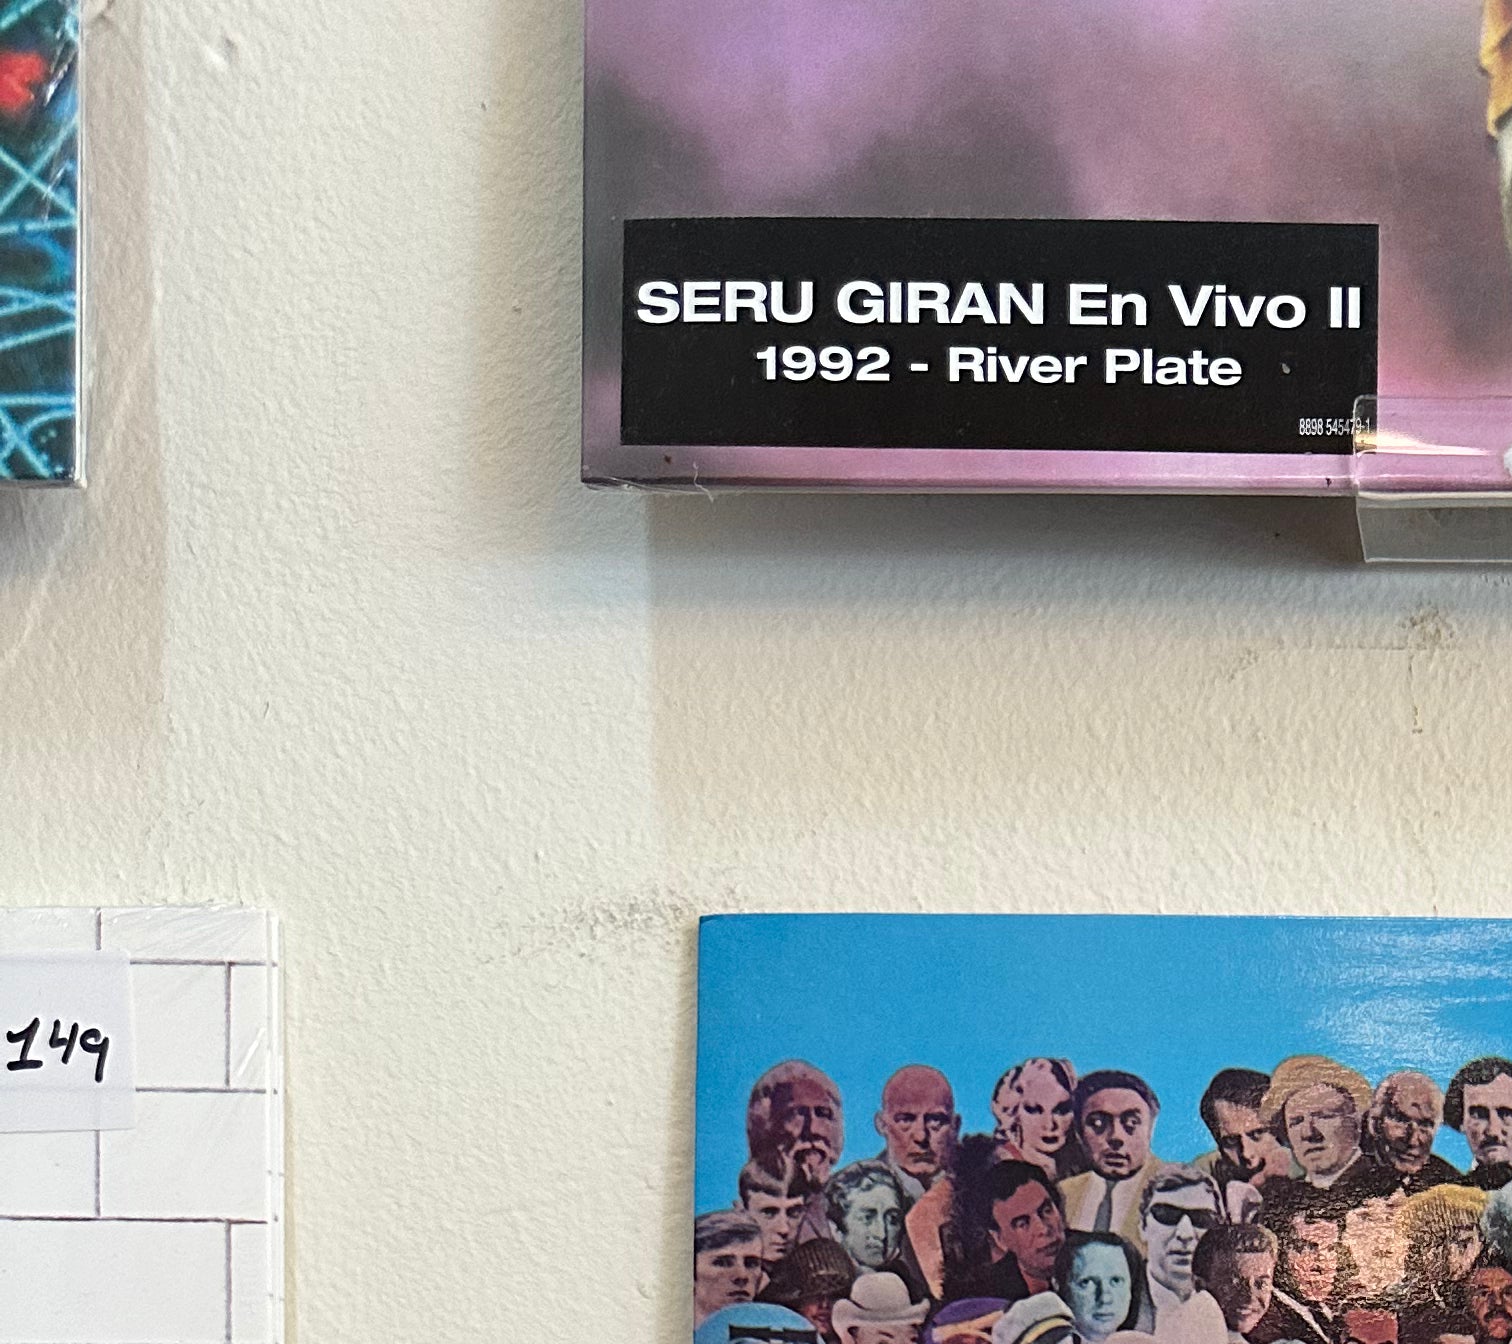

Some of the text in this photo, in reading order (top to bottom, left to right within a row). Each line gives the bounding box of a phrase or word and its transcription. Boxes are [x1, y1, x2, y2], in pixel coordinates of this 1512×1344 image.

[636, 280, 1362, 330] SERU GIRAN En Vivo II
[756, 346, 891, 382] 1992
[947, 346, 1088, 385] River
[1104, 348, 1243, 387] Plate
[1299, 418, 1324, 436] 8898
[6, 1017, 110, 1083] 149
